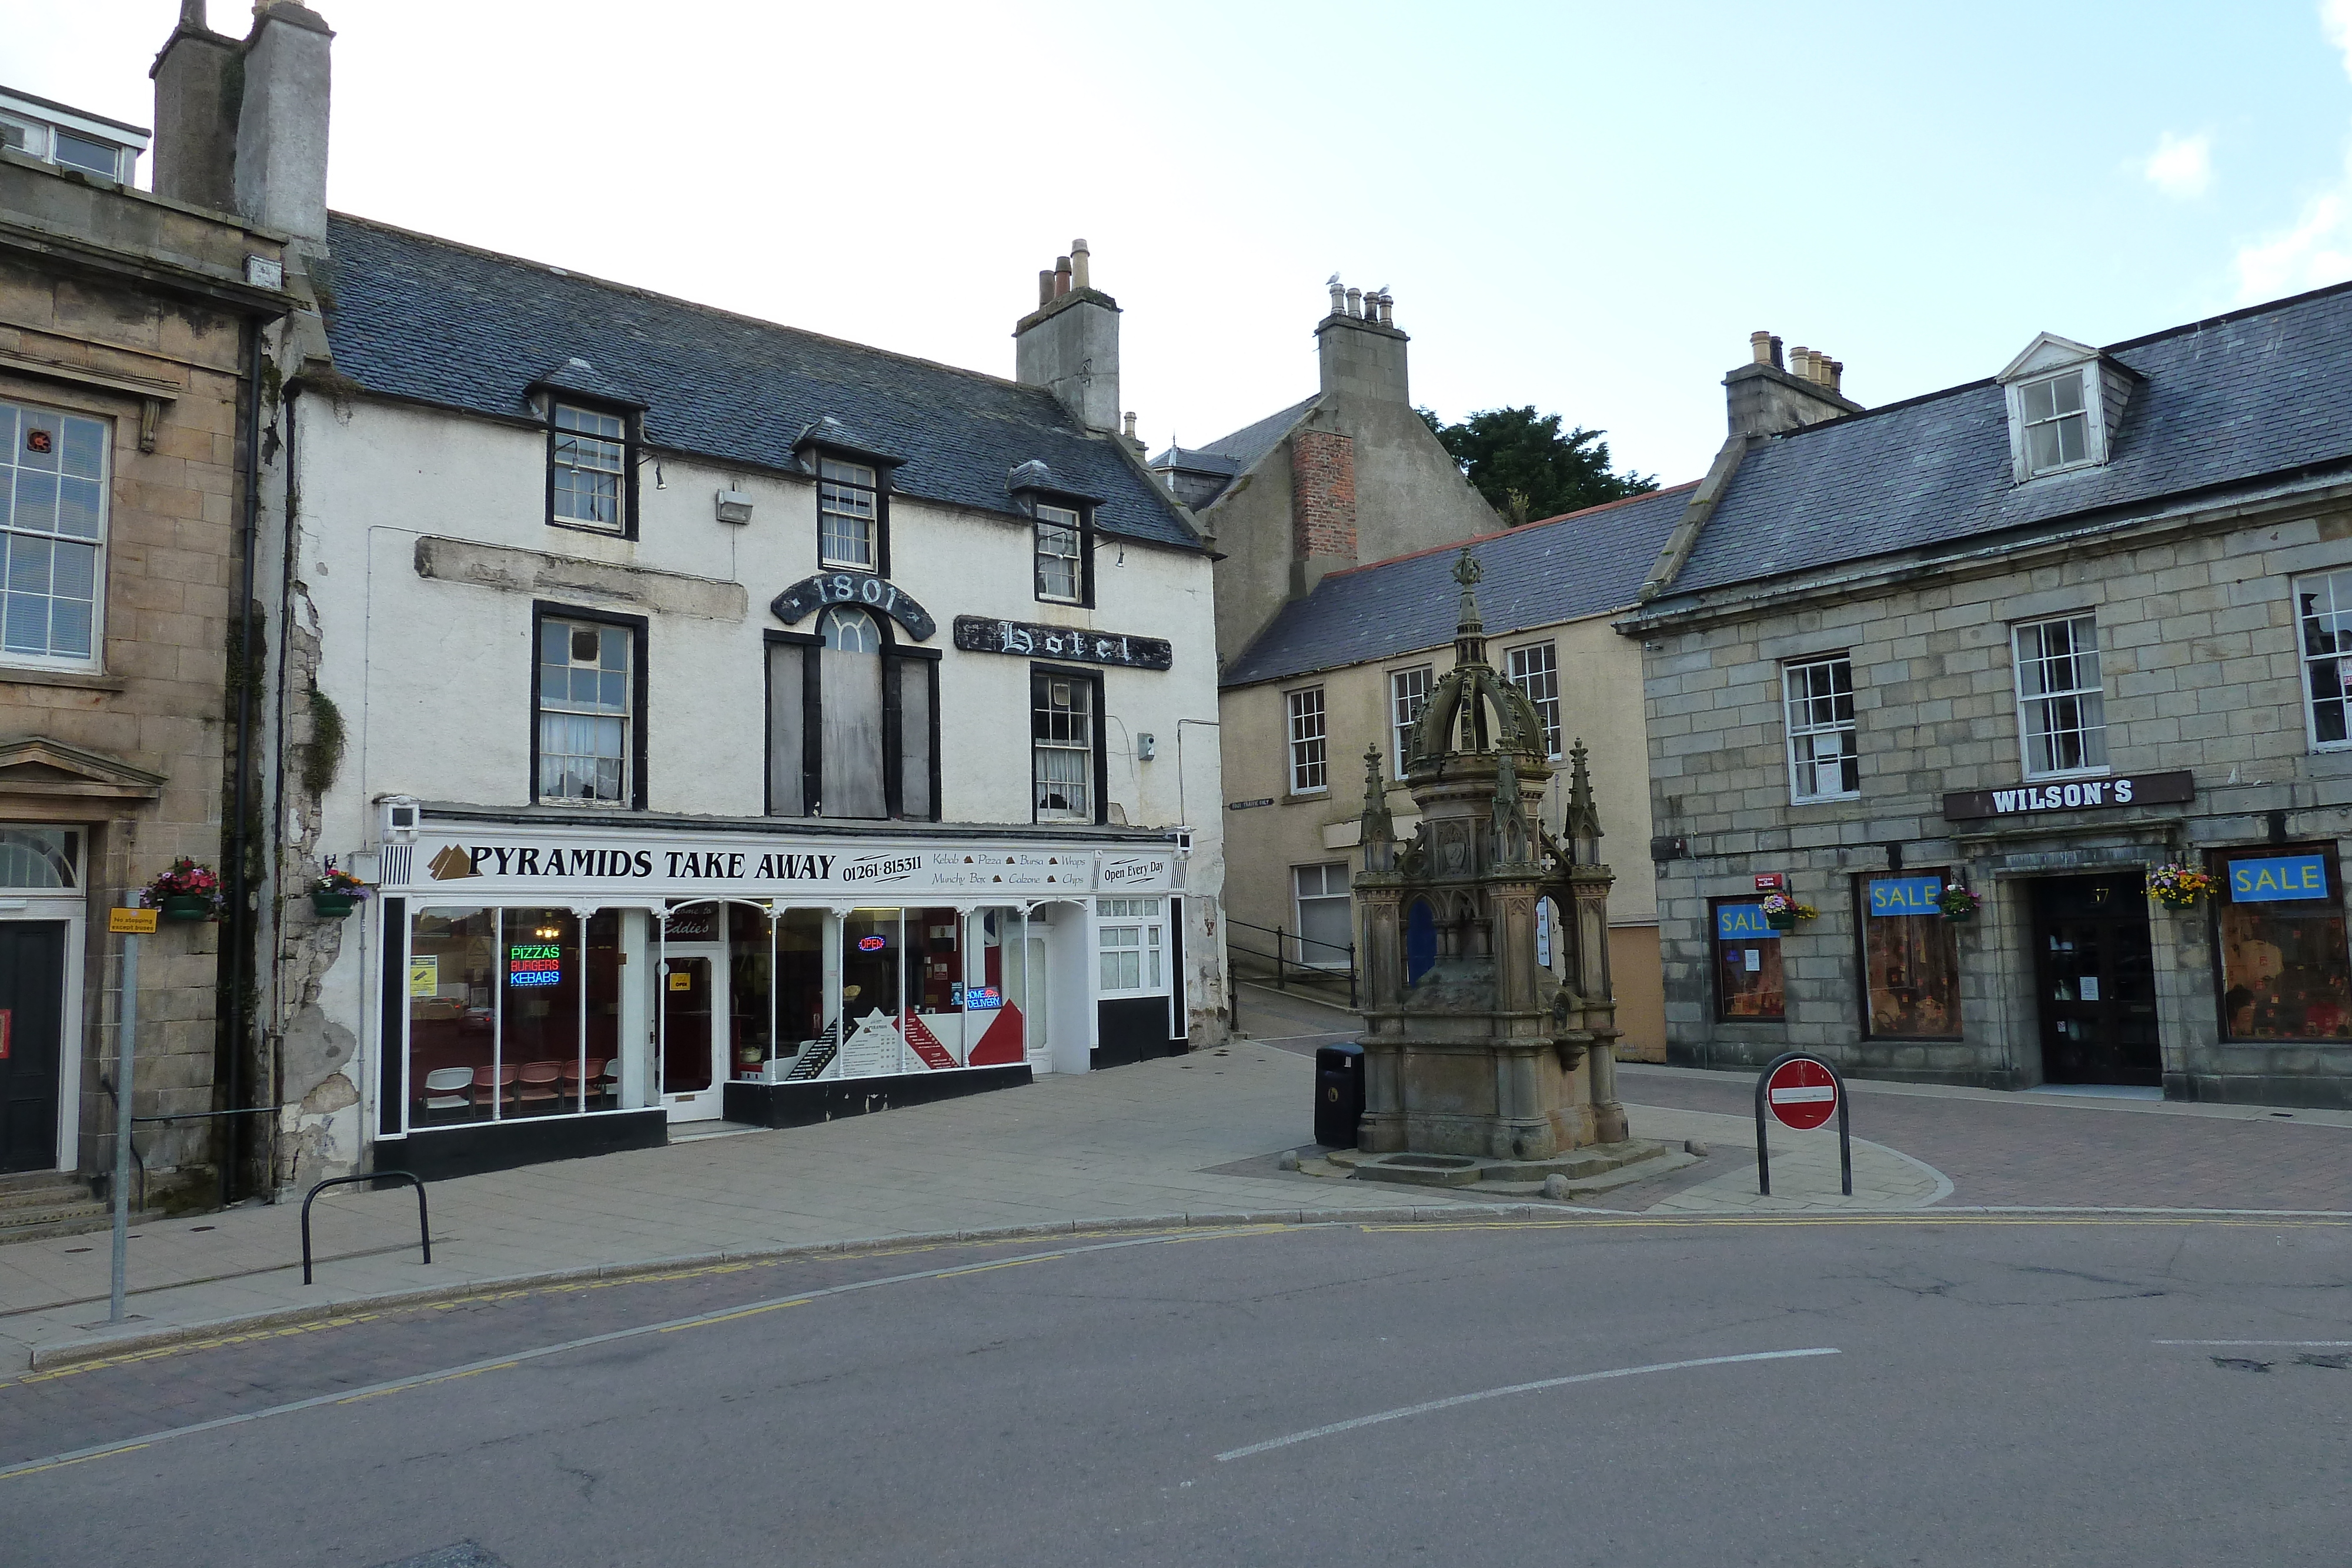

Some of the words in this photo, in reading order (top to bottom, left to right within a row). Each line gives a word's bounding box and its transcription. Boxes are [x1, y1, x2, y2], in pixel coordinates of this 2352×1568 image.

[813, 574, 897, 611] 1801
[1992, 780, 2133, 813] WILSON'S
[469, 846, 653, 878] PYRAMIDS
[664, 851, 746, 880] TAKE
[754, 854, 837, 880] AWAY
[932, 853, 959, 865] Kebab
[978, 854, 1001, 865] Pizza
[1020, 855, 1044, 866] Bursa
[1062, 855, 1086, 868] Wraps
[931, 873, 965, 886] Munchy
[969, 874, 987, 884] Box
[1009, 874, 1040, 884] Calzone
[1062, 874, 1084, 887] Chips
[1104, 870, 1125, 883] Open
[1127, 864, 1148, 877] Every
[1150, 861, 1164, 873] Day
[2236, 865, 2320, 892] SALE
[1875, 885, 1937, 908] SALE
[1722, 912, 1770, 932] SAL
[860, 939, 883, 948] OPEN
[511, 947, 560, 959] PIZZAS
[511, 959, 559, 972] BURGERS
[510, 971, 560, 984] KEBABS
[967, 997, 1000, 1008] DELIVERY
